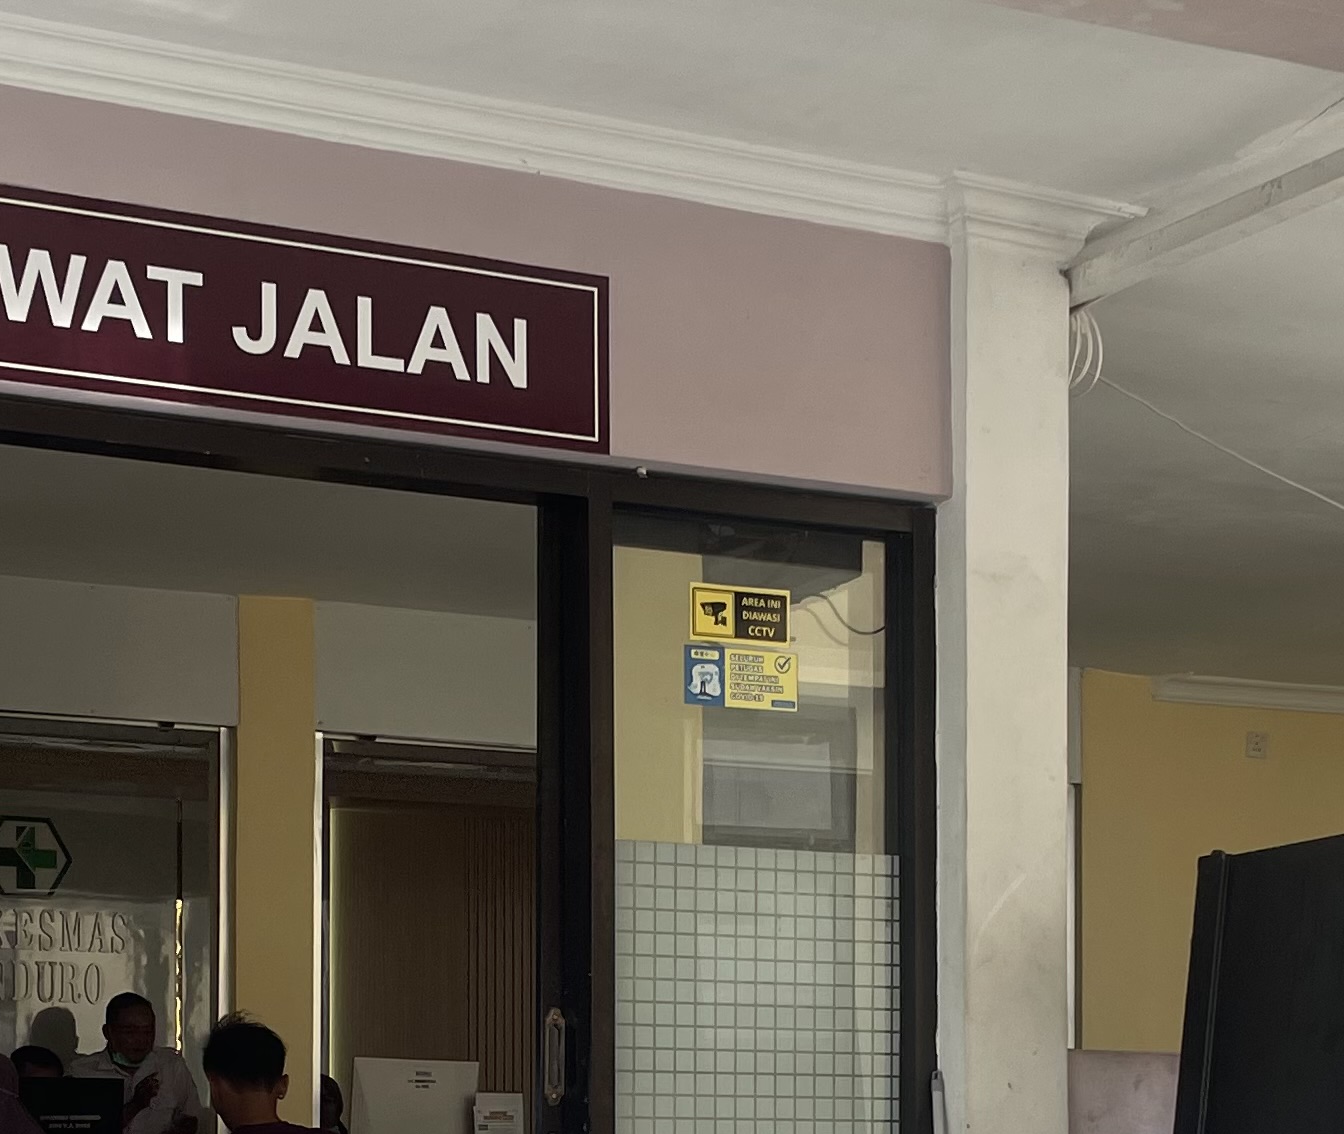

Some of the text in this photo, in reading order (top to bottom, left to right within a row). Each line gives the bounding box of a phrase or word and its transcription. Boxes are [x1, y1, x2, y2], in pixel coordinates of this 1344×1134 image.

[232, 282, 527, 388] JALAN
[741, 597, 781, 609] AREA INI
[742, 611, 781, 622] DIAWASI
[748, 625, 775, 638] CCTV
